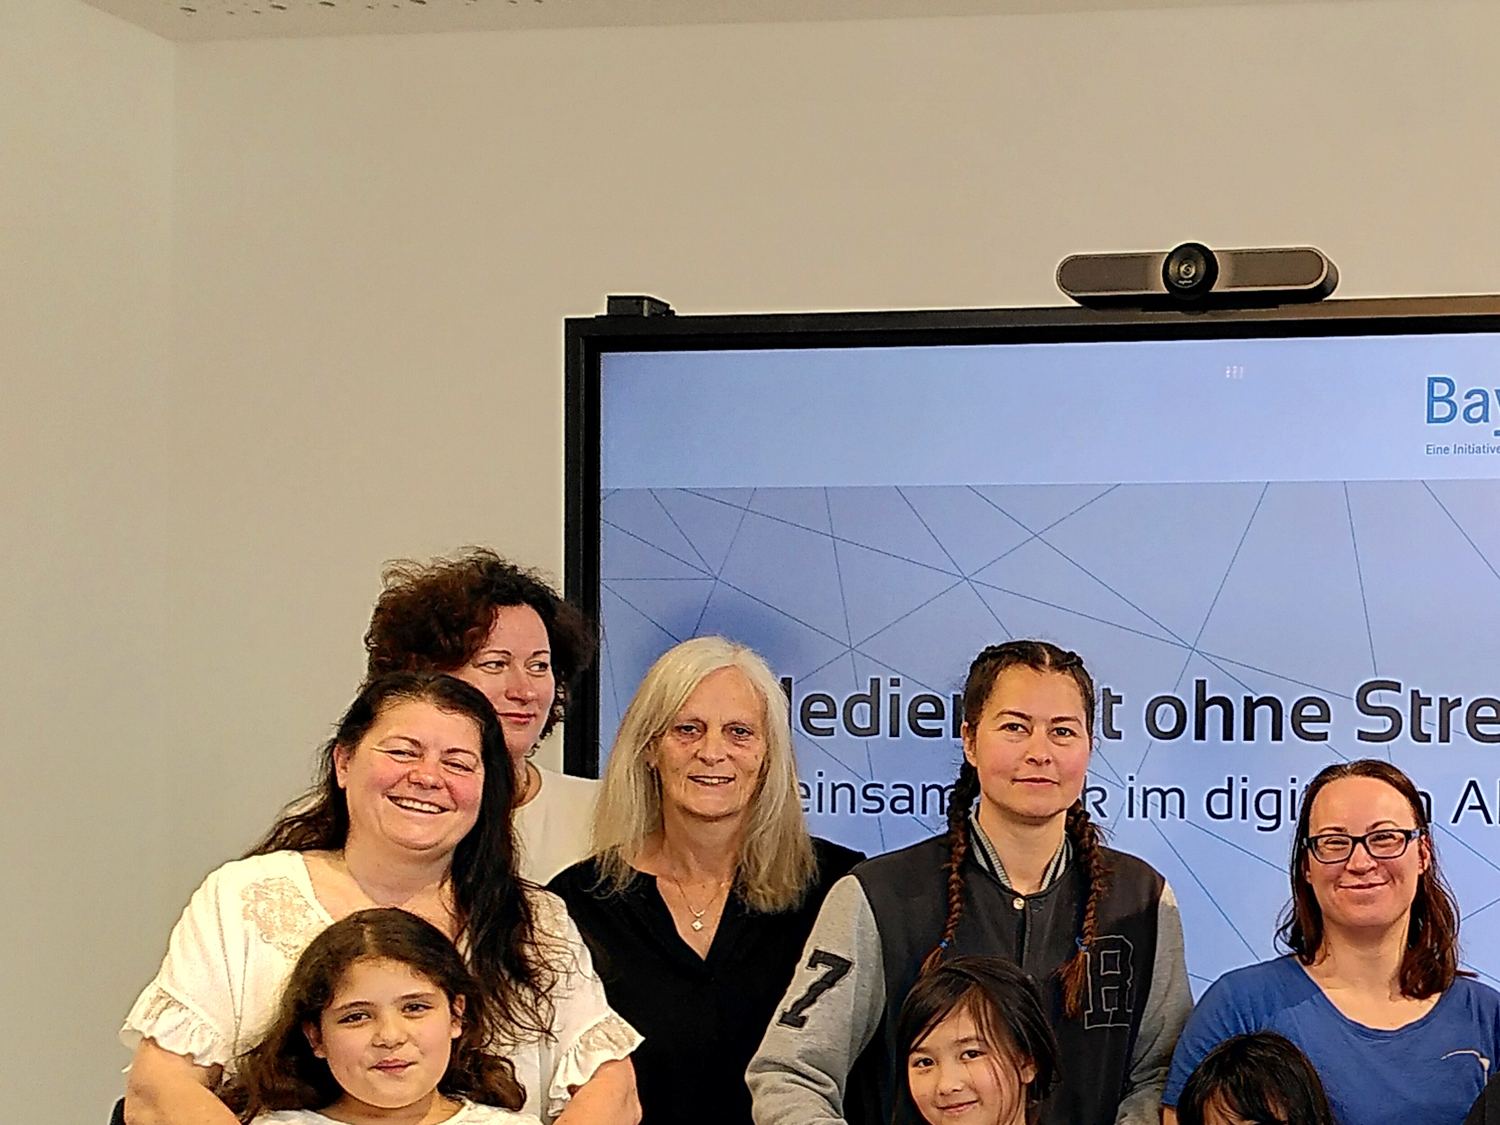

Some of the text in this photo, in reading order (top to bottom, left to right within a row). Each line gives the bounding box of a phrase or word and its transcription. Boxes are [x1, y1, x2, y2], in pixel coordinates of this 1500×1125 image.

[1426, 444, 1450, 455] Eine
[1145, 678, 1331, 742] ohne
[1127, 775, 1186, 820] im
[776, 949, 855, 1031] 7
